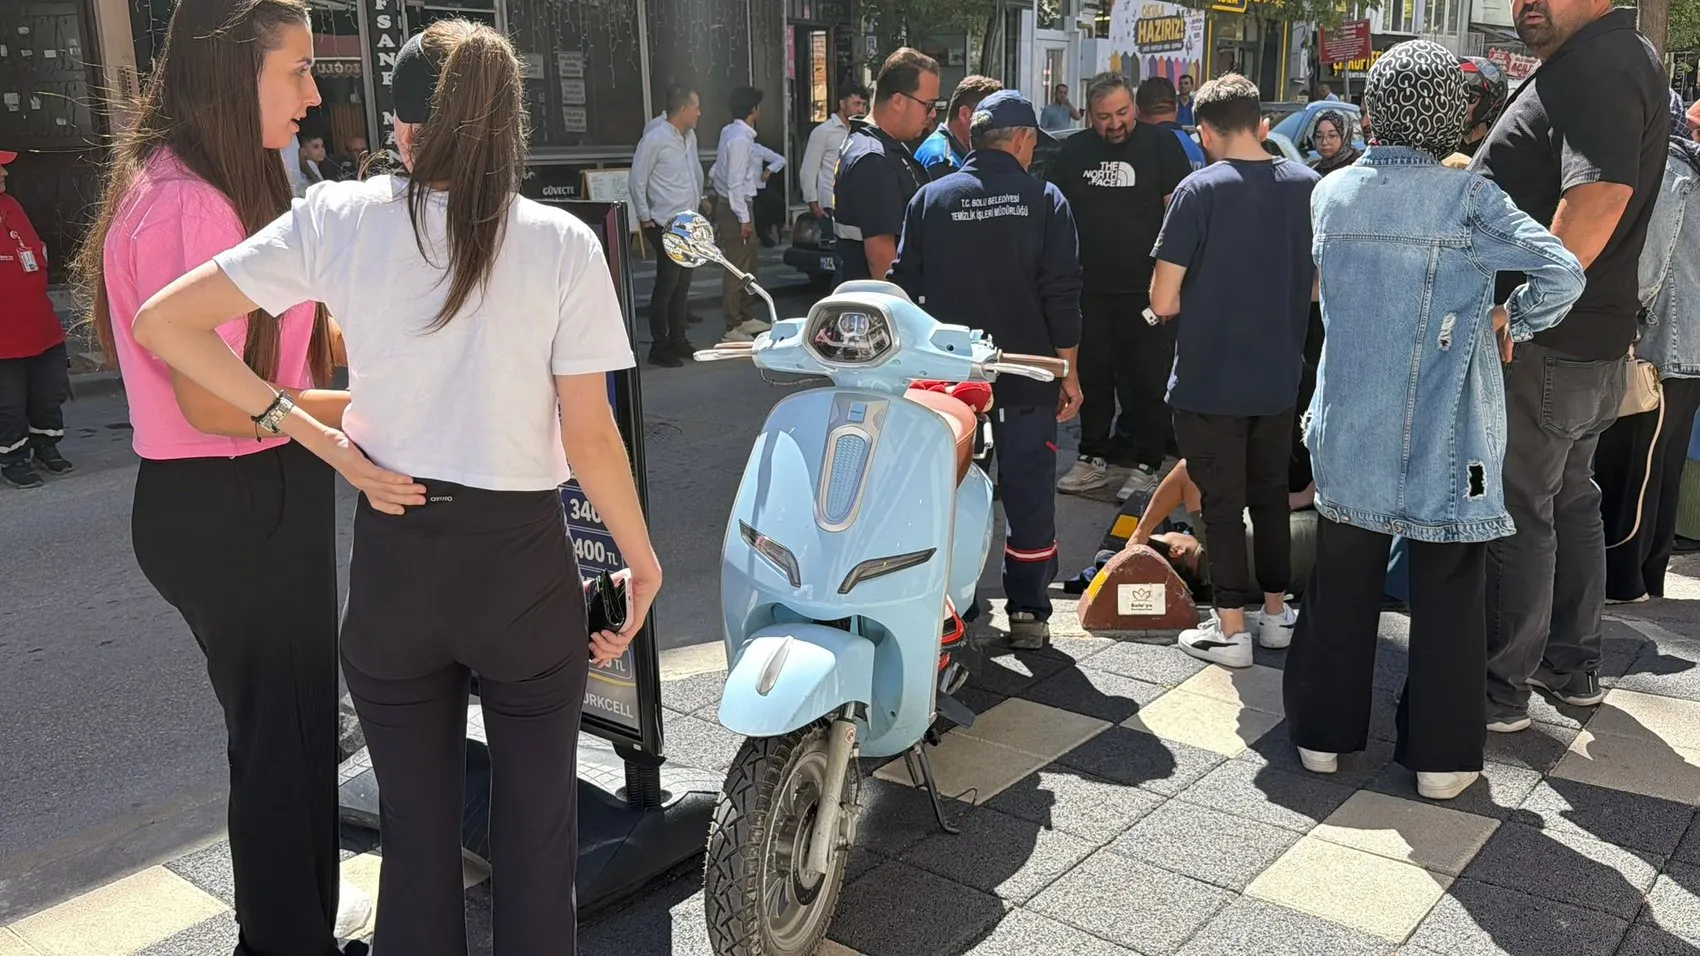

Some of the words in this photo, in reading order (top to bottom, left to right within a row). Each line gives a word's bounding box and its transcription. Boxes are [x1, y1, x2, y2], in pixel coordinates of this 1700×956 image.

[1138, 18, 1184, 43] HAZIRIZ!
[1100, 161, 1119, 170] THE
[1082, 169, 1117, 179] NORTH
[1091, 178, 1116, 187] FACE
[542, 185, 575, 196] GÜVEÇTE
[971, 197, 987, 207] BOLU
[987, 193, 1020, 206] BELEDİYESİ
[574, 538, 605, 563] 400
[606, 551, 618, 566] TL
